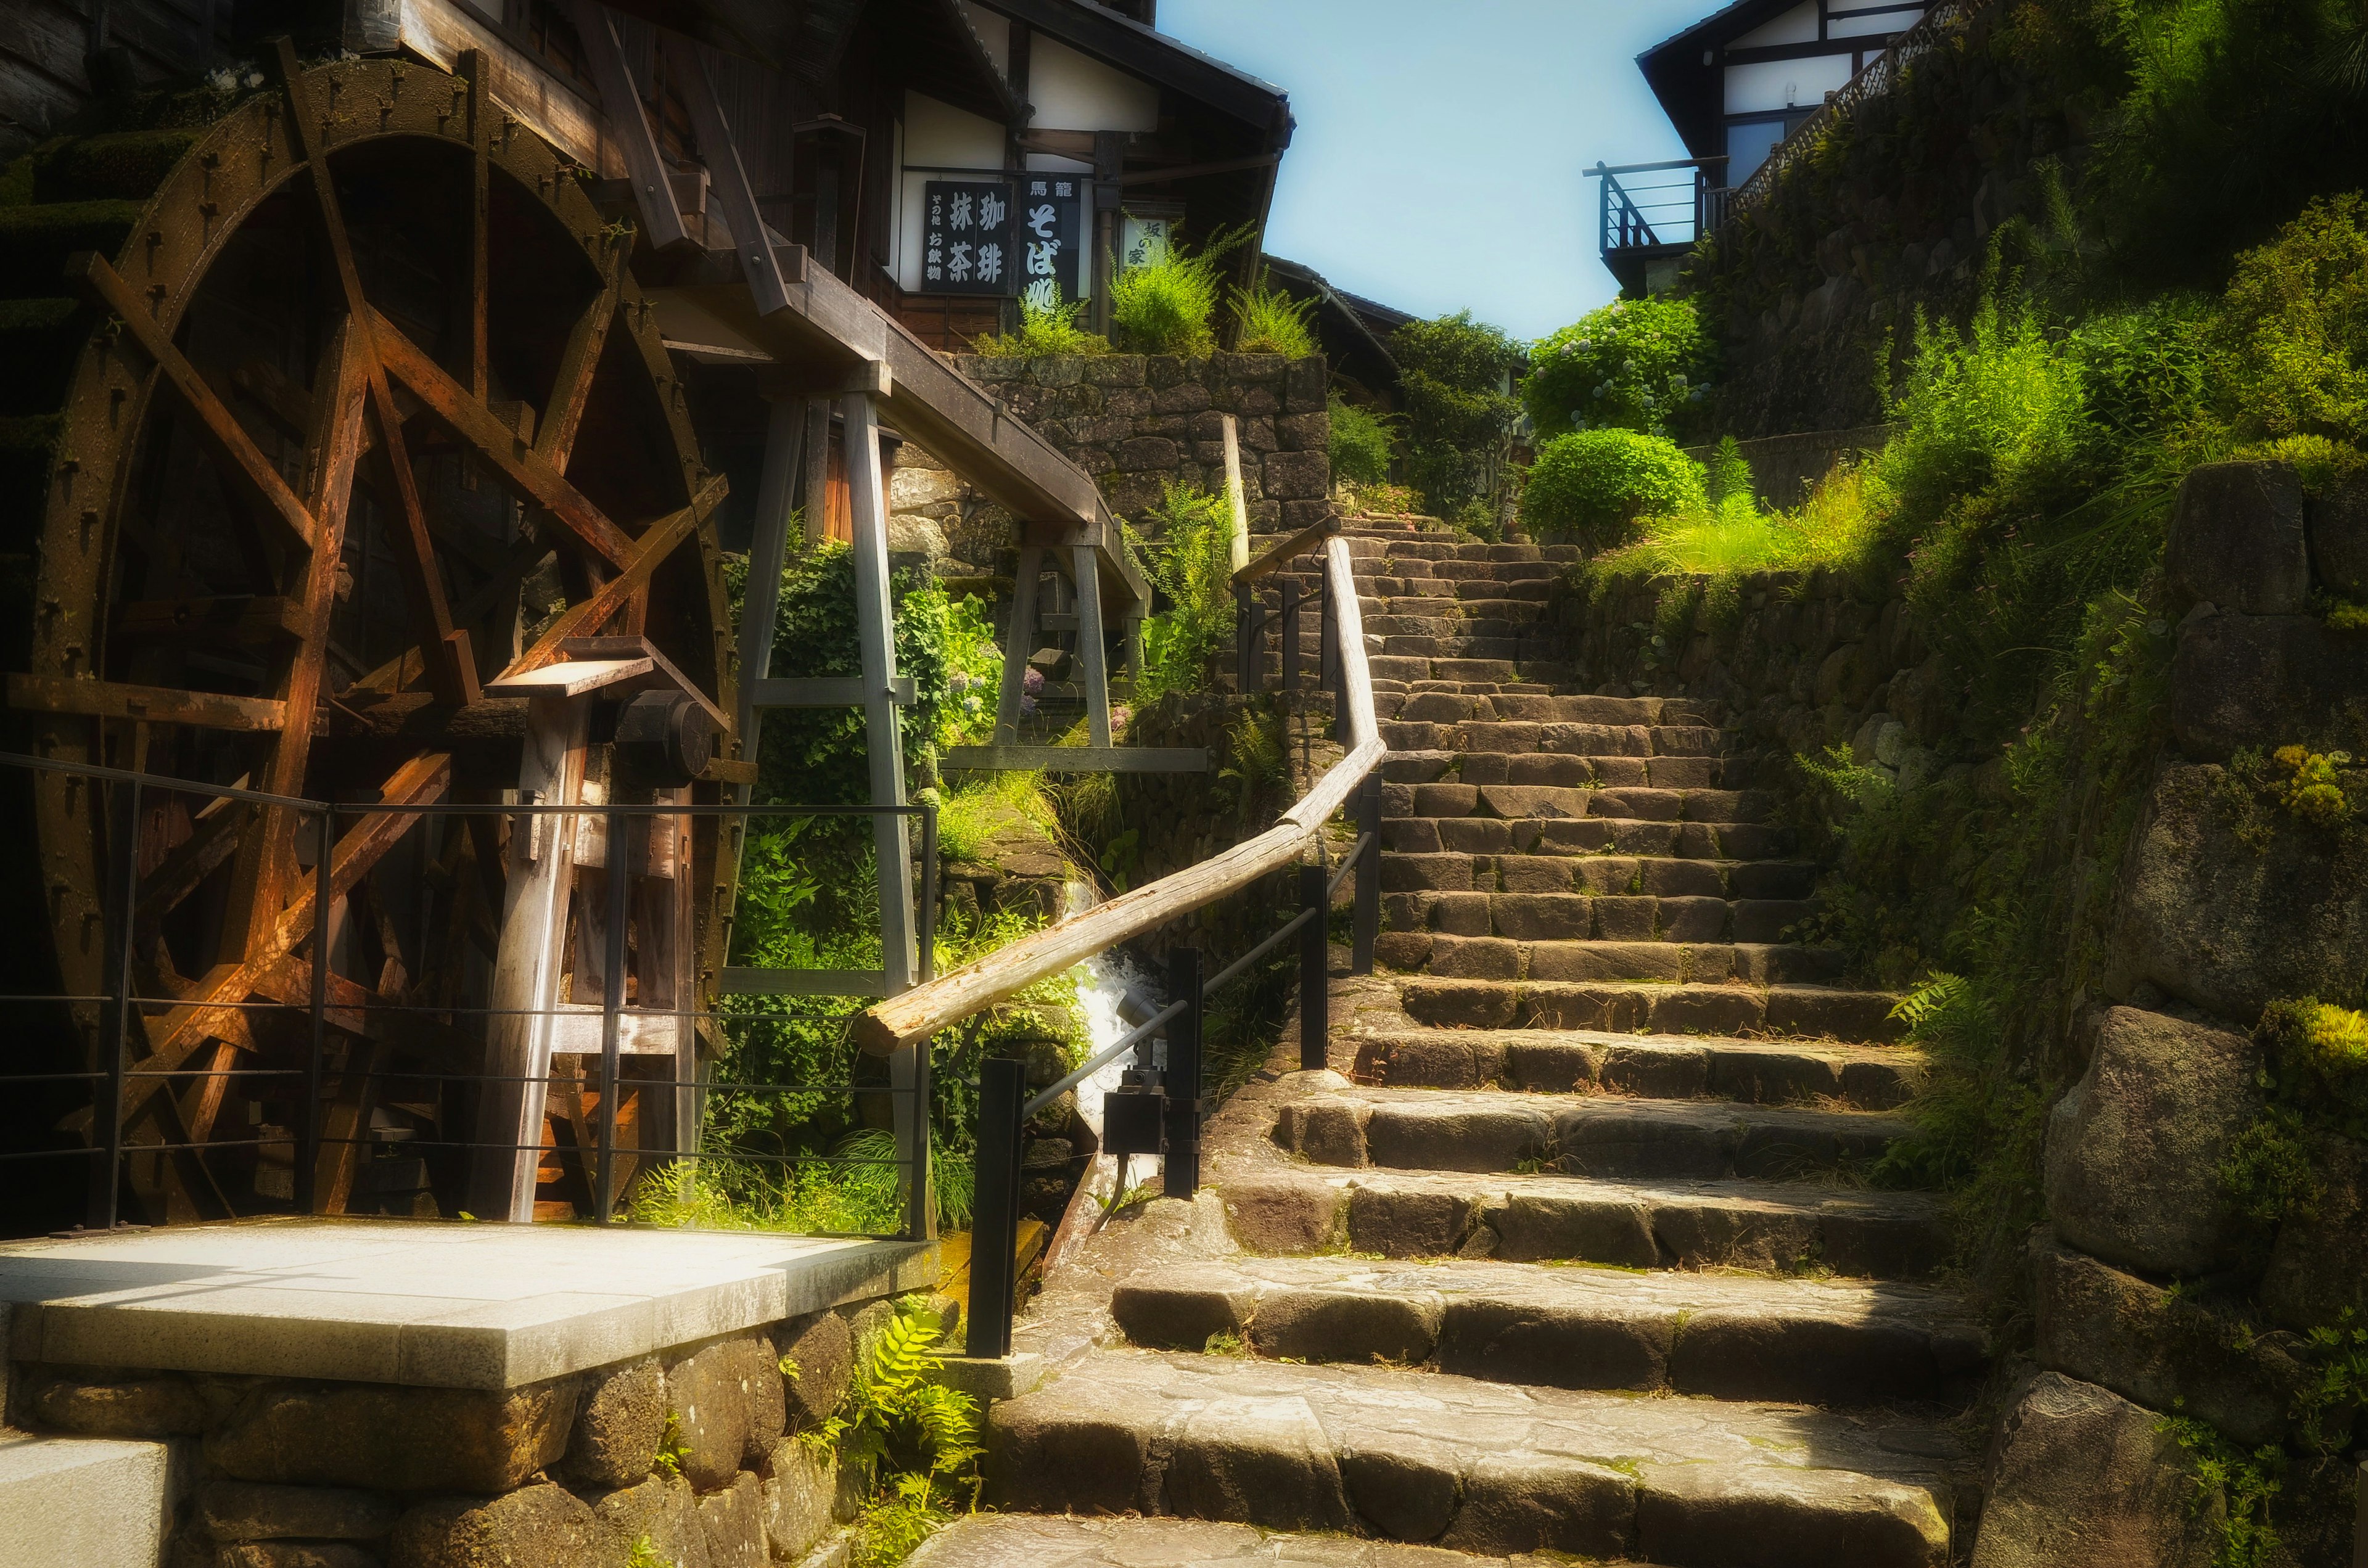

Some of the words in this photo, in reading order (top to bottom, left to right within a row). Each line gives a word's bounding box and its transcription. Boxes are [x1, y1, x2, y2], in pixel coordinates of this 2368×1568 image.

[1030, 181, 1072, 197] 馬籠
[947, 192, 973, 282] 抹茶
[977, 191, 1006, 284] 珈琲
